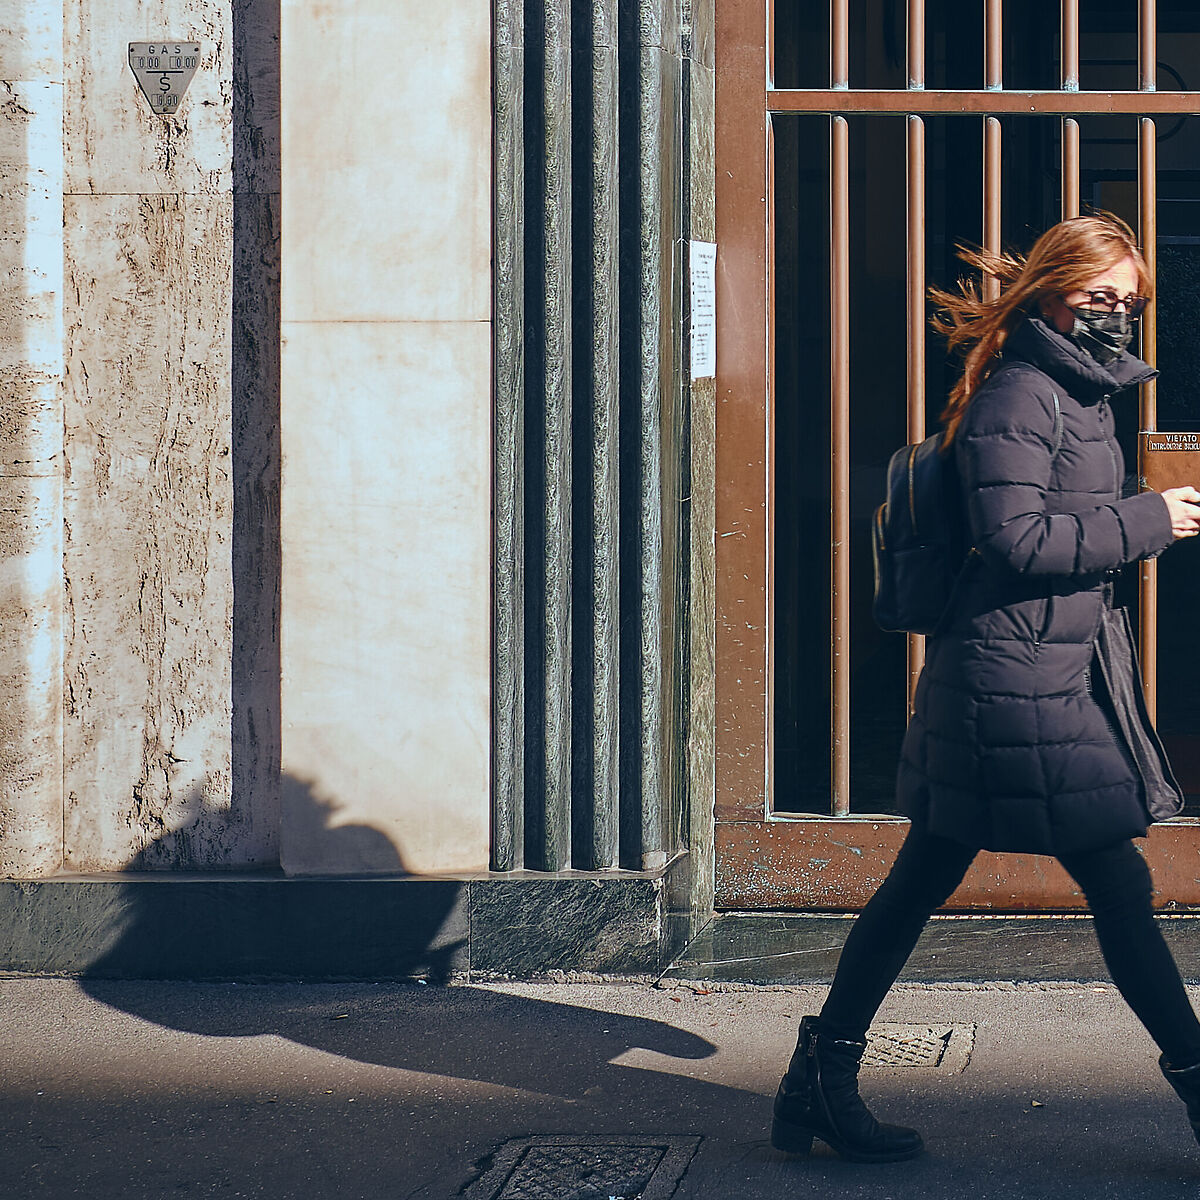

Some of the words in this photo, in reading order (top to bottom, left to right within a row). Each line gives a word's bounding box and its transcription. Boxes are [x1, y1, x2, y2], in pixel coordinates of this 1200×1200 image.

[148, 45, 181, 54] GAS
[159, 76, 171, 92] S
[1165, 434, 1197, 442] VIETATO
